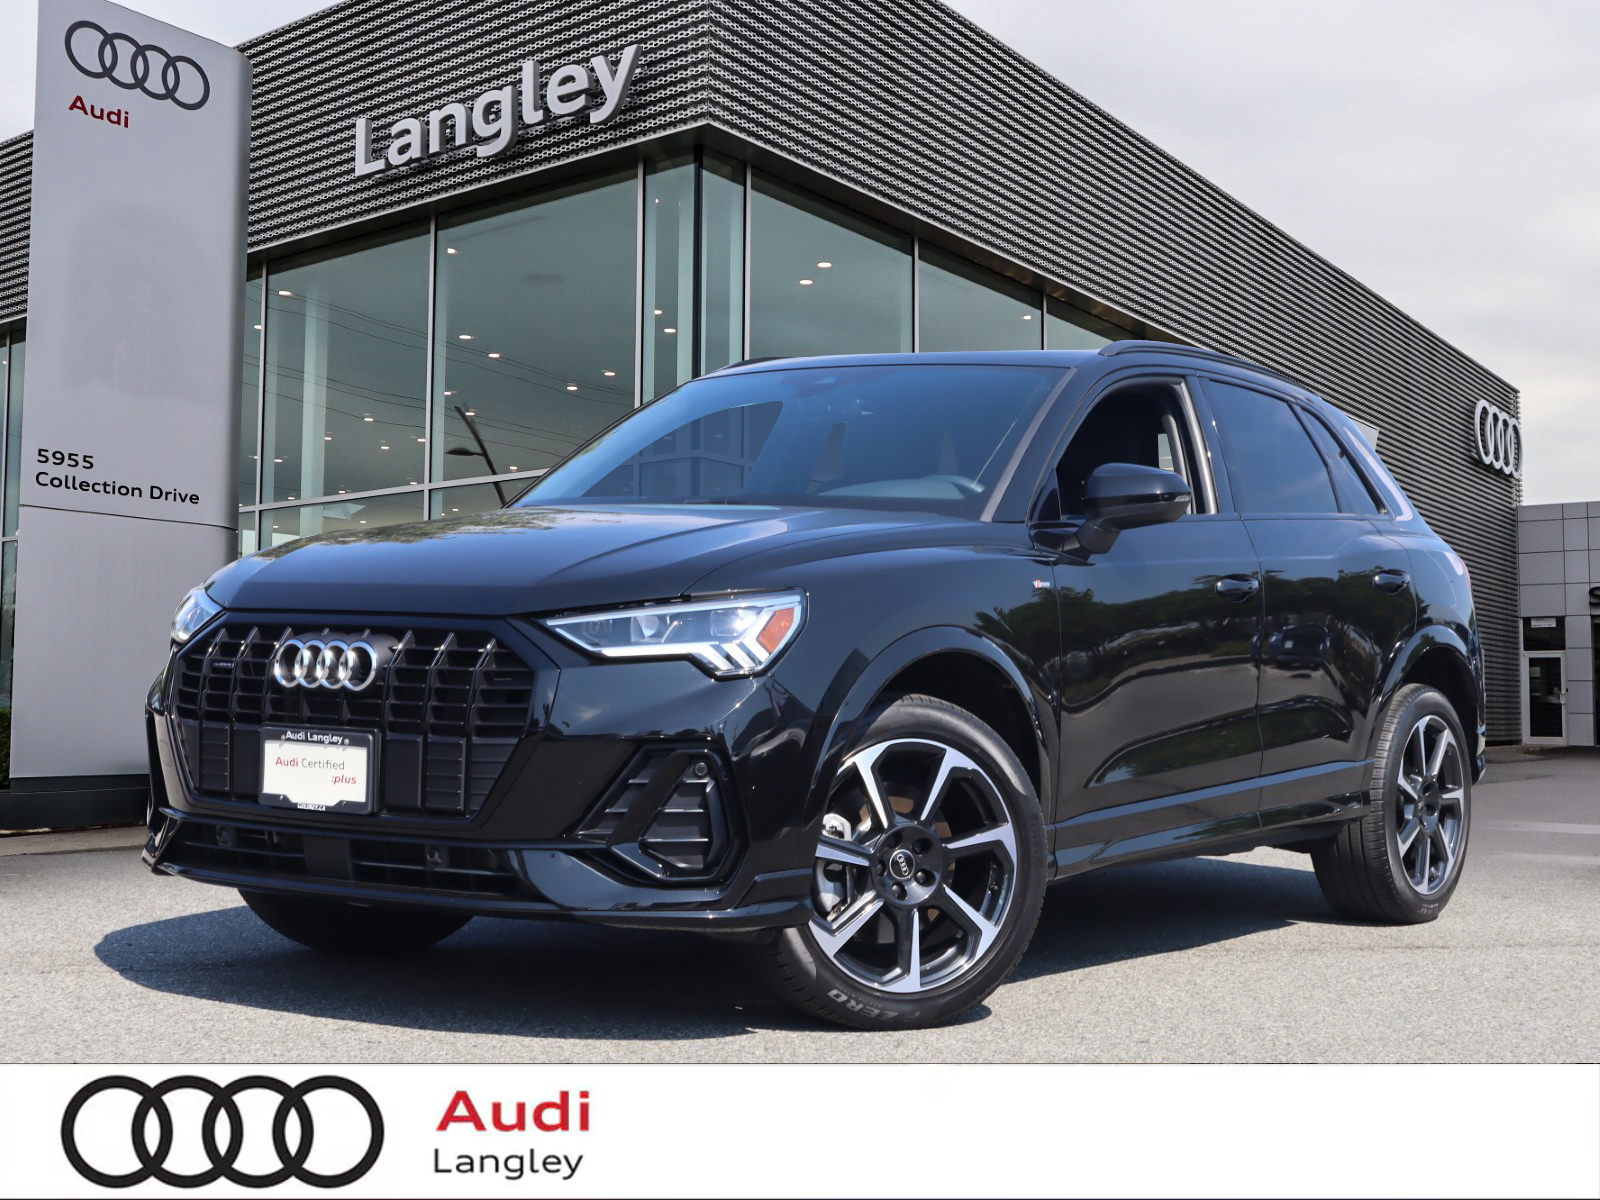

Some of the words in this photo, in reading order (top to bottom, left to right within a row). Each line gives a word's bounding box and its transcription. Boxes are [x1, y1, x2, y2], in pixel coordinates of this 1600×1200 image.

[68, 95, 129, 129] Audi
[355, 44, 643, 177] Langley
[37, 448, 94, 470] 5955
[35, 471, 142, 498] Collection
[150, 485, 200, 504] Drive
[286, 730, 306, 741] Audi
[307, 732, 344, 745] Langley
[275, 757, 299, 767] Audi
[301, 758, 345, 771] Certified
[827, 989, 899, 1023] ZERO
